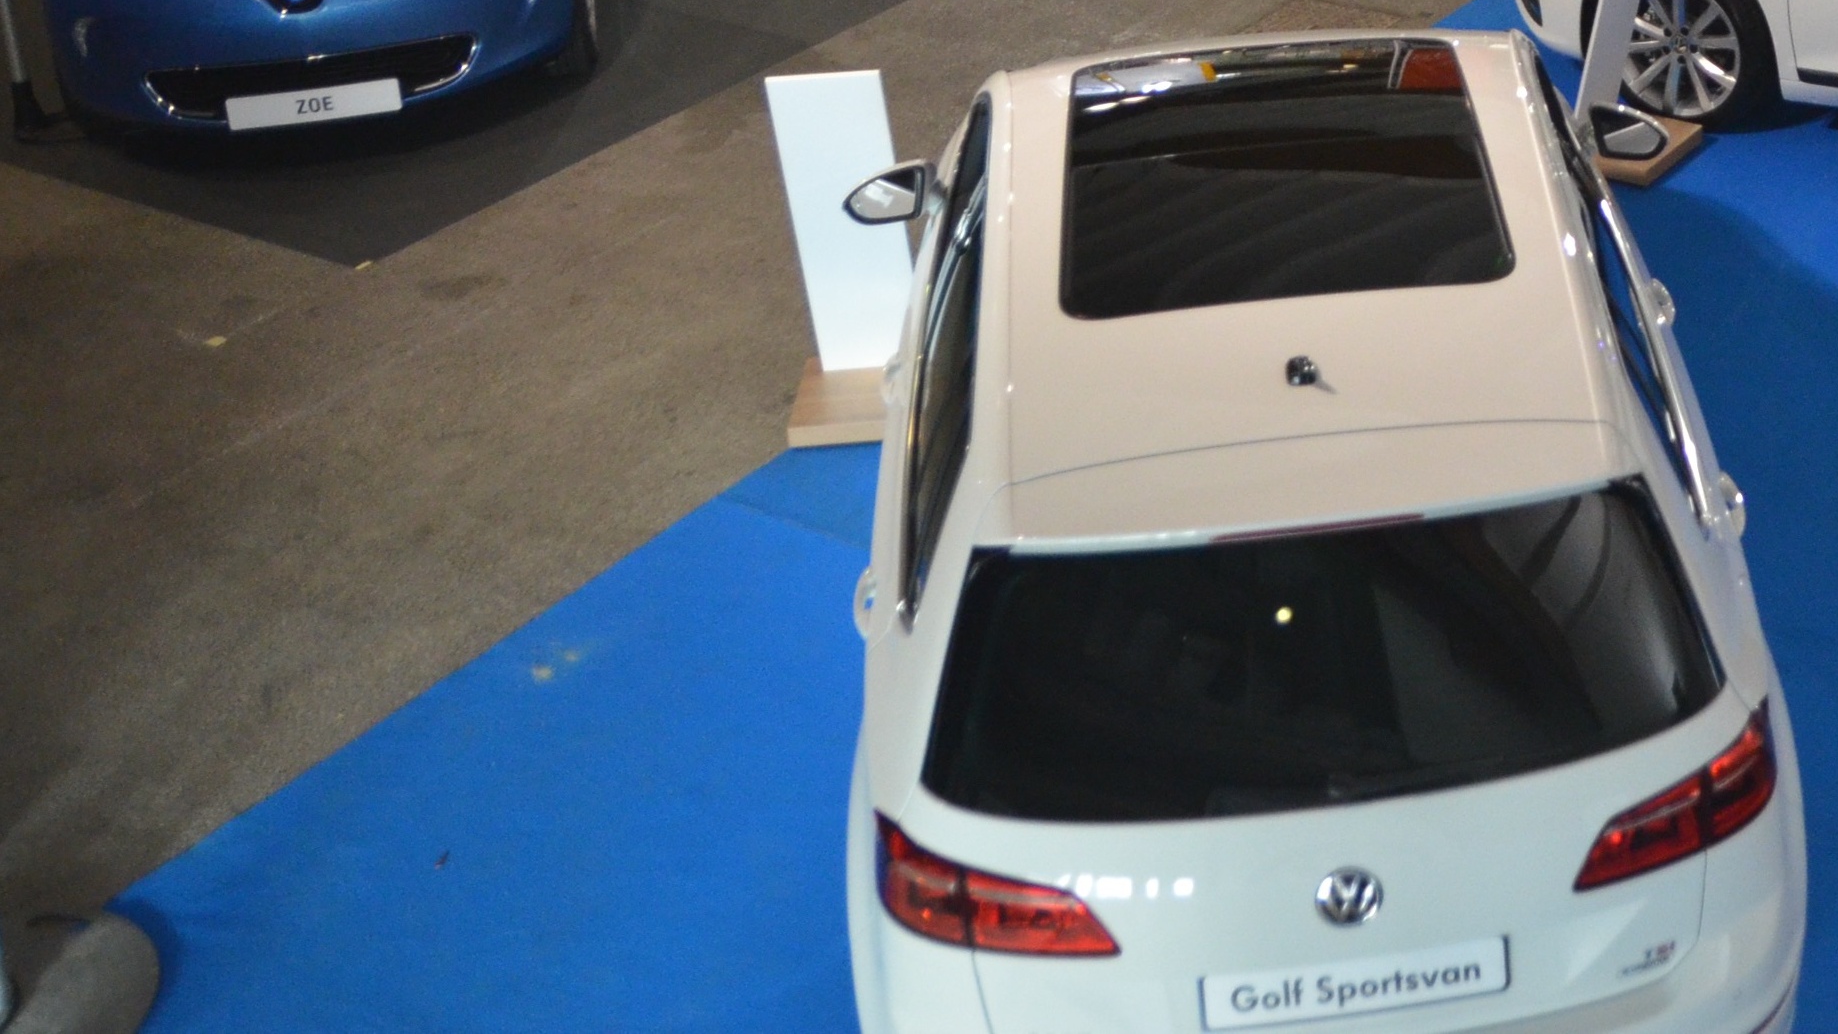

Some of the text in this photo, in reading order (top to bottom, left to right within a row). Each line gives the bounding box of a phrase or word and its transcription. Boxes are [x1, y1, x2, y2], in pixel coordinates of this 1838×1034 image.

[295, 96, 334, 115] ZOE
[1230, 962, 1482, 1013] Golf Sportsvan
